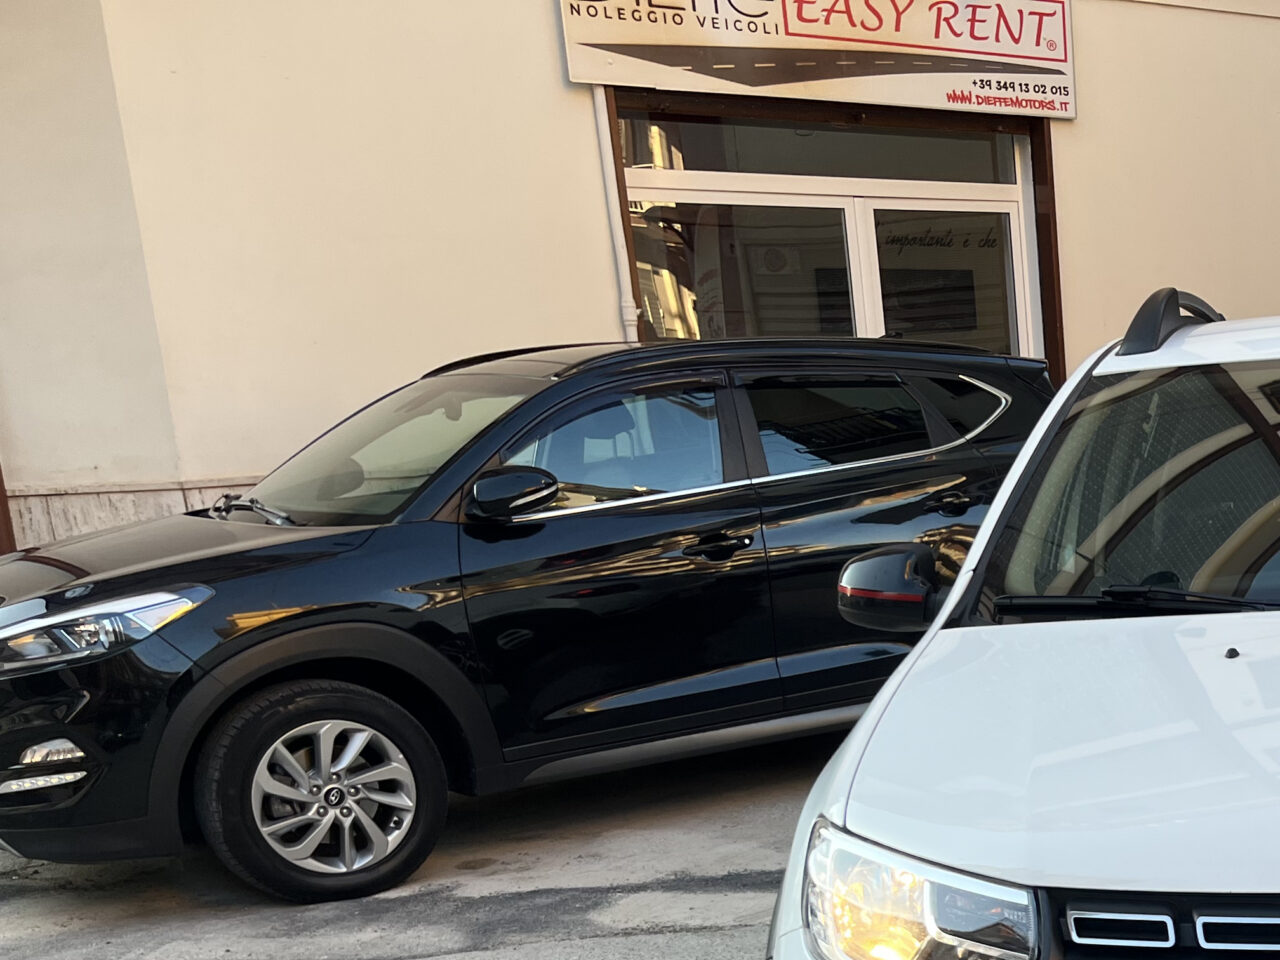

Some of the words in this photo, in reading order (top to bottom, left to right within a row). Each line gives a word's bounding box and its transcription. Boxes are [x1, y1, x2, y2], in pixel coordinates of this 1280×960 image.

[570, 3, 684, 26] NOLEGGIO
[696, 15, 779, 36] VEICOLI
[796, 0, 916, 32] EASY
[928, 2, 1057, 47] RENT
[972, 79, 992, 91] +39
[996, 80, 1015, 93] 349
[1019, 83, 1030, 94] 13
[1033, 84, 1048, 95] 02
[1051, 85, 1069, 96] 015
[978, 227, 998, 248] che
